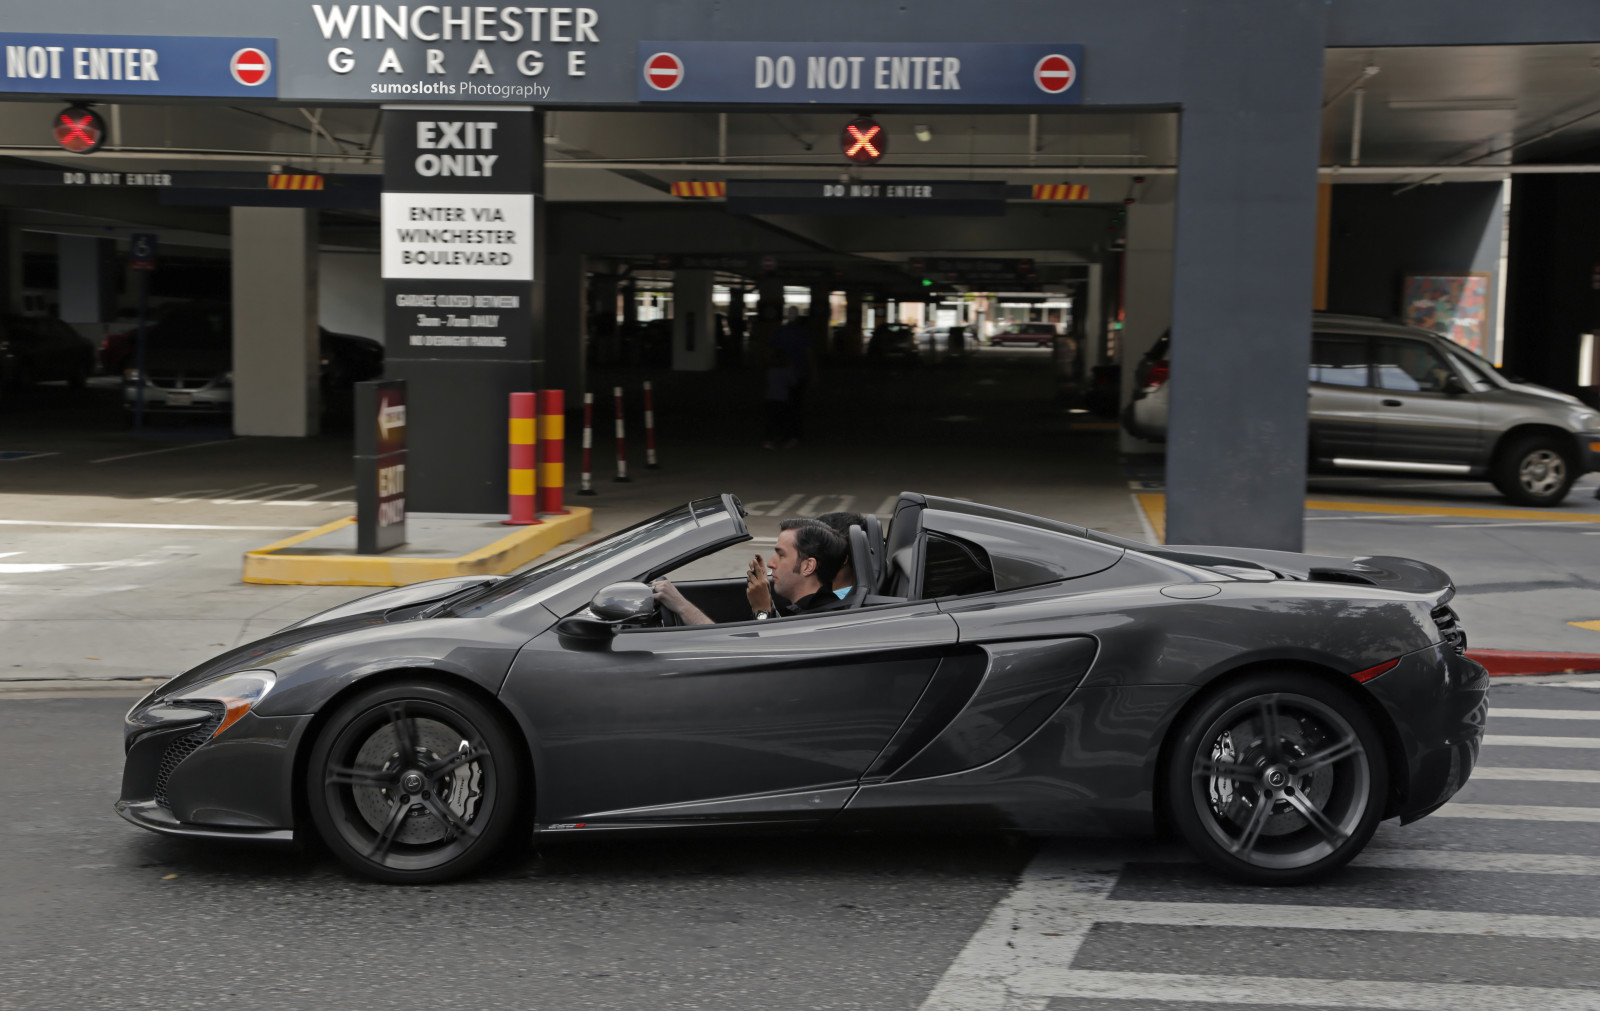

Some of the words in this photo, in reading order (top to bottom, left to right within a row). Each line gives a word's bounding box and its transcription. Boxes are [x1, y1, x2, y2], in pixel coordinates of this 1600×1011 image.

[312, 4, 599, 43] WINCHESTER
[6, 45, 65, 80] NOT
[73, 47, 160, 82] ENTER
[327, 47, 587, 77] GARAGE
[755, 55, 796, 89] DO
[807, 56, 867, 90] NOT
[874, 56, 962, 91] ENTER
[416, 121, 498, 150] EXIT
[63, 172, 86, 185] DO
[90, 172, 121, 185] NOT
[126, 173, 172, 186] ENTER
[414, 153, 499, 177] ONLY
[823, 184, 844, 197] DO
[849, 185, 880, 198] NOT
[886, 185, 933, 198] ENTER
[409, 207, 466, 222] ENTER
[471, 208, 505, 223] VIA
[397, 228, 517, 245] WINCHESTER
[402, 250, 513, 266] BOULEVARD
[378, 465, 405, 498] EXIT
[378, 497, 406, 528] ONLY
